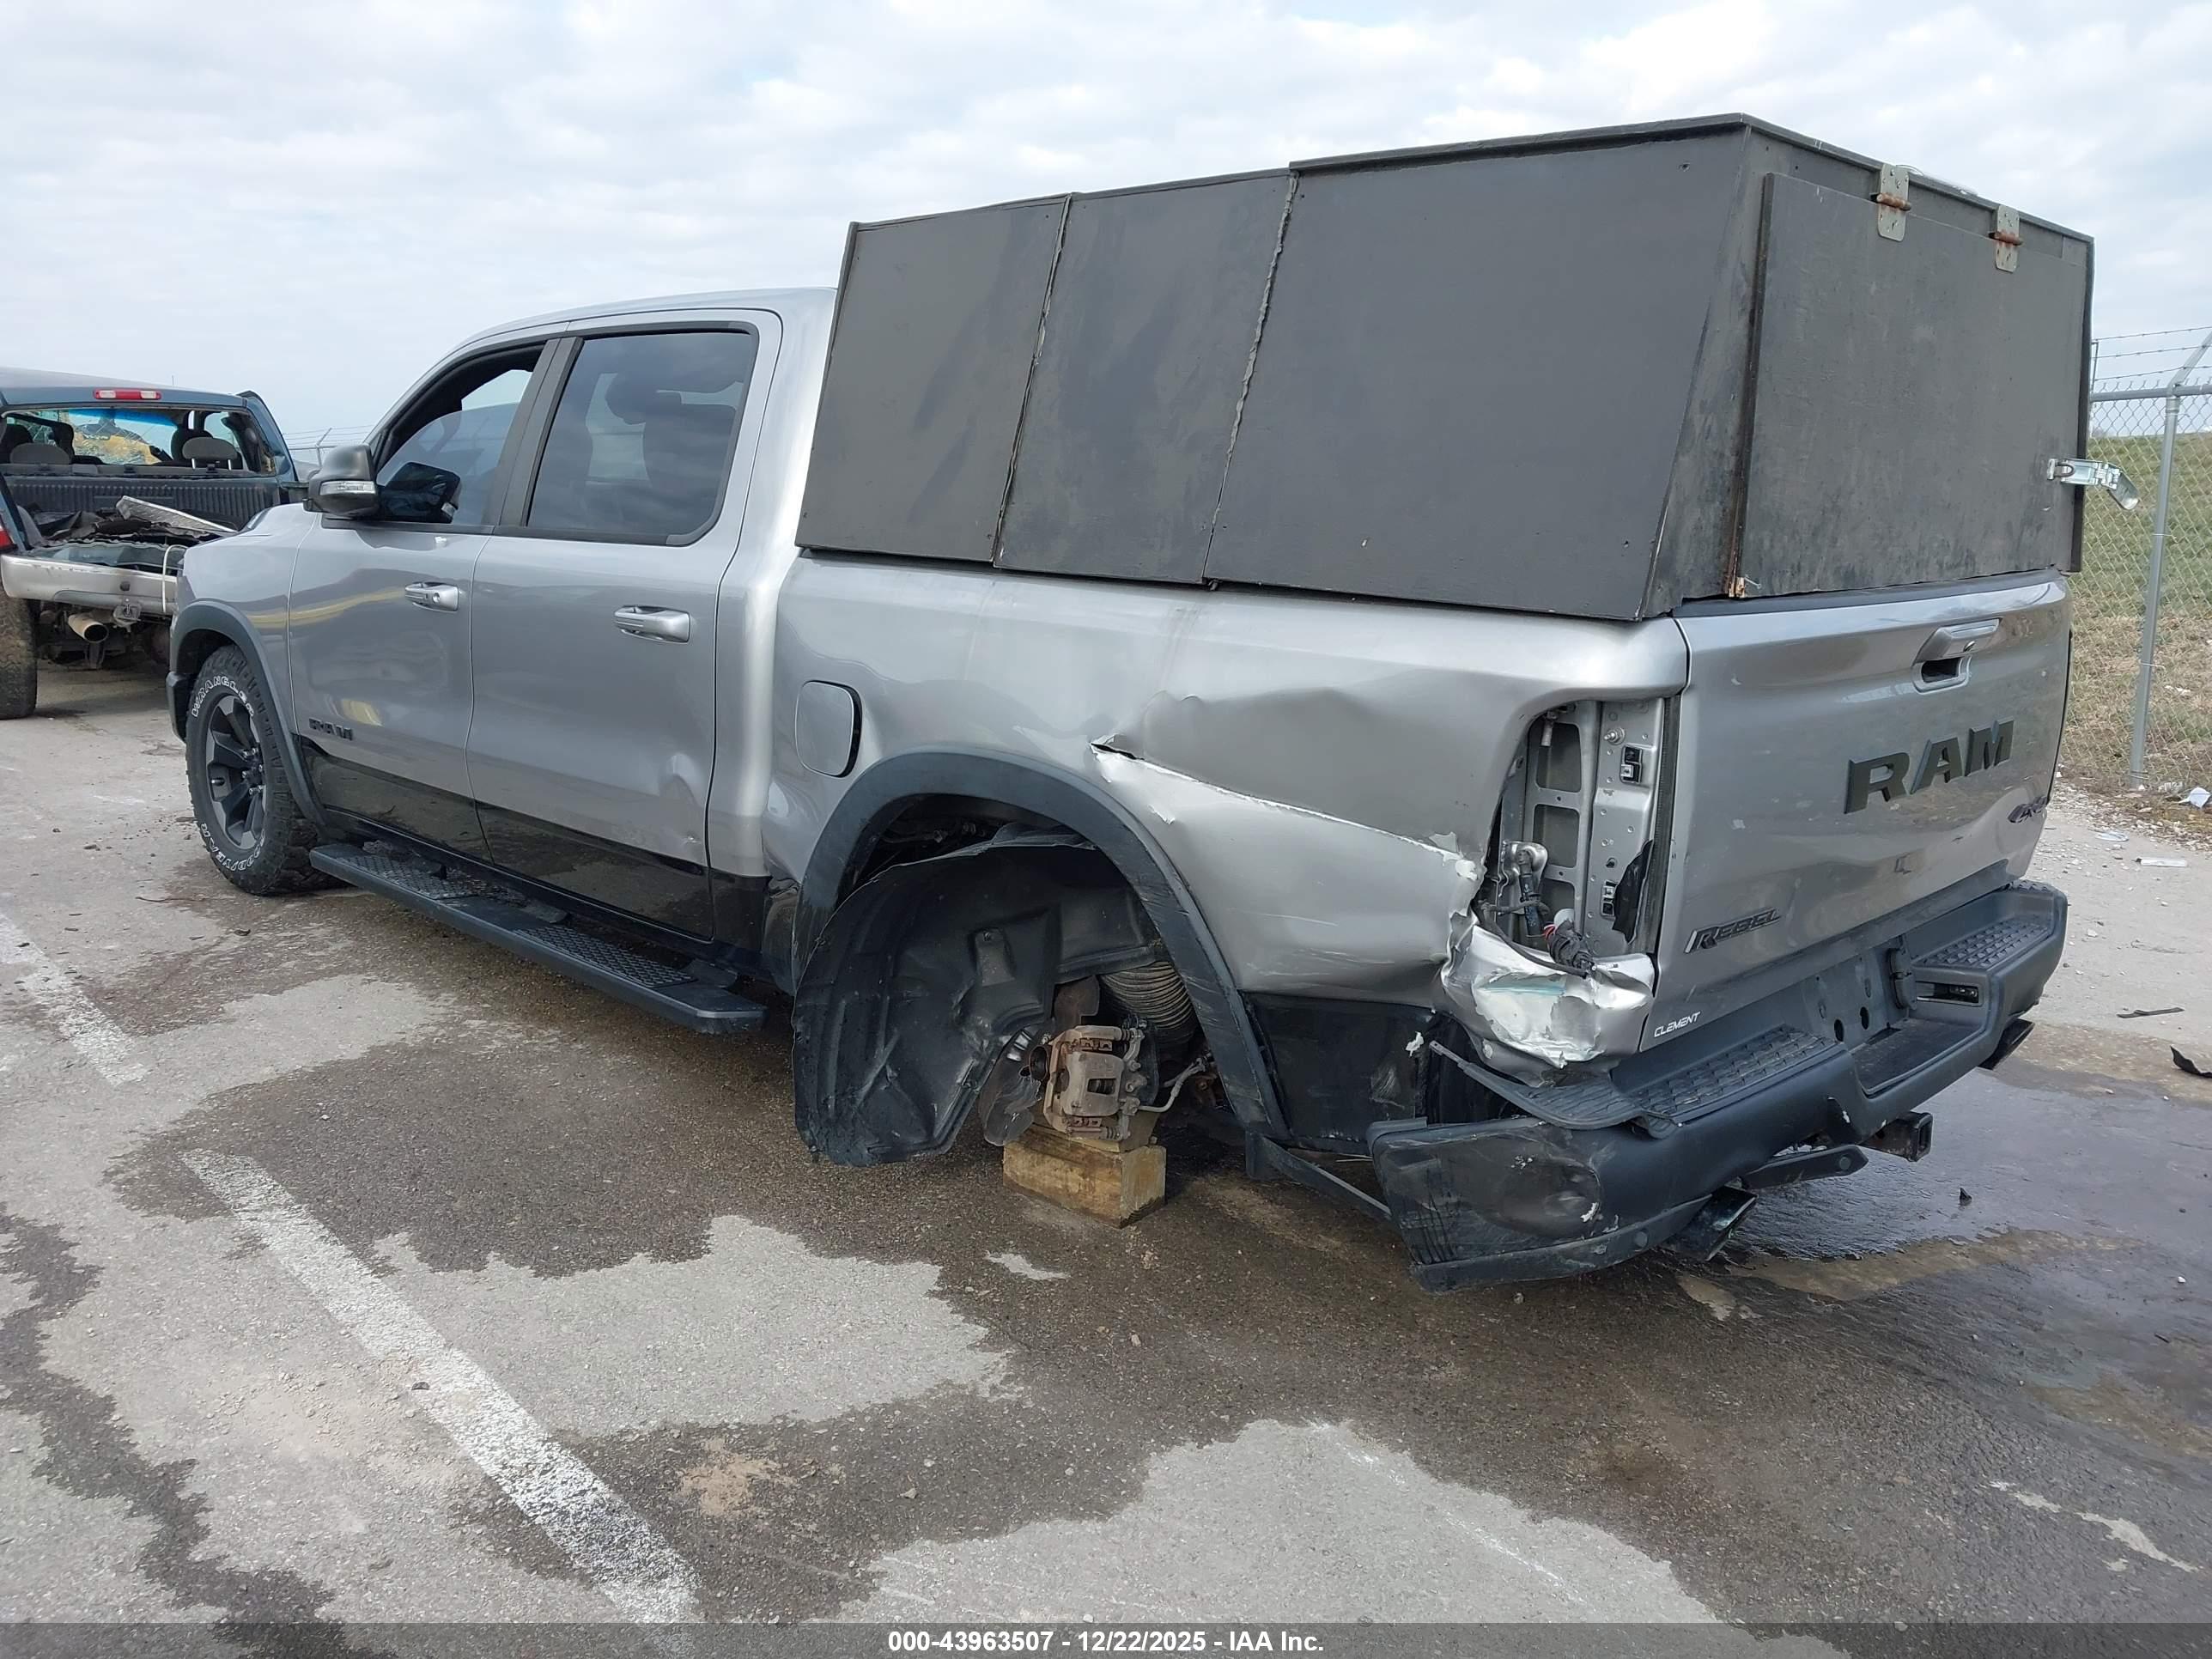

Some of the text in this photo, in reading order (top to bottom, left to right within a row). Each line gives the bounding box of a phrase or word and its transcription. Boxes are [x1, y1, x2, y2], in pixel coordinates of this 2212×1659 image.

[191, 675, 255, 718] WRANGLER
[1844, 716, 2014, 814] RAM
[1683, 907, 1782, 954] REBEL
[1654, 1012, 1701, 1038] CLEMENT
